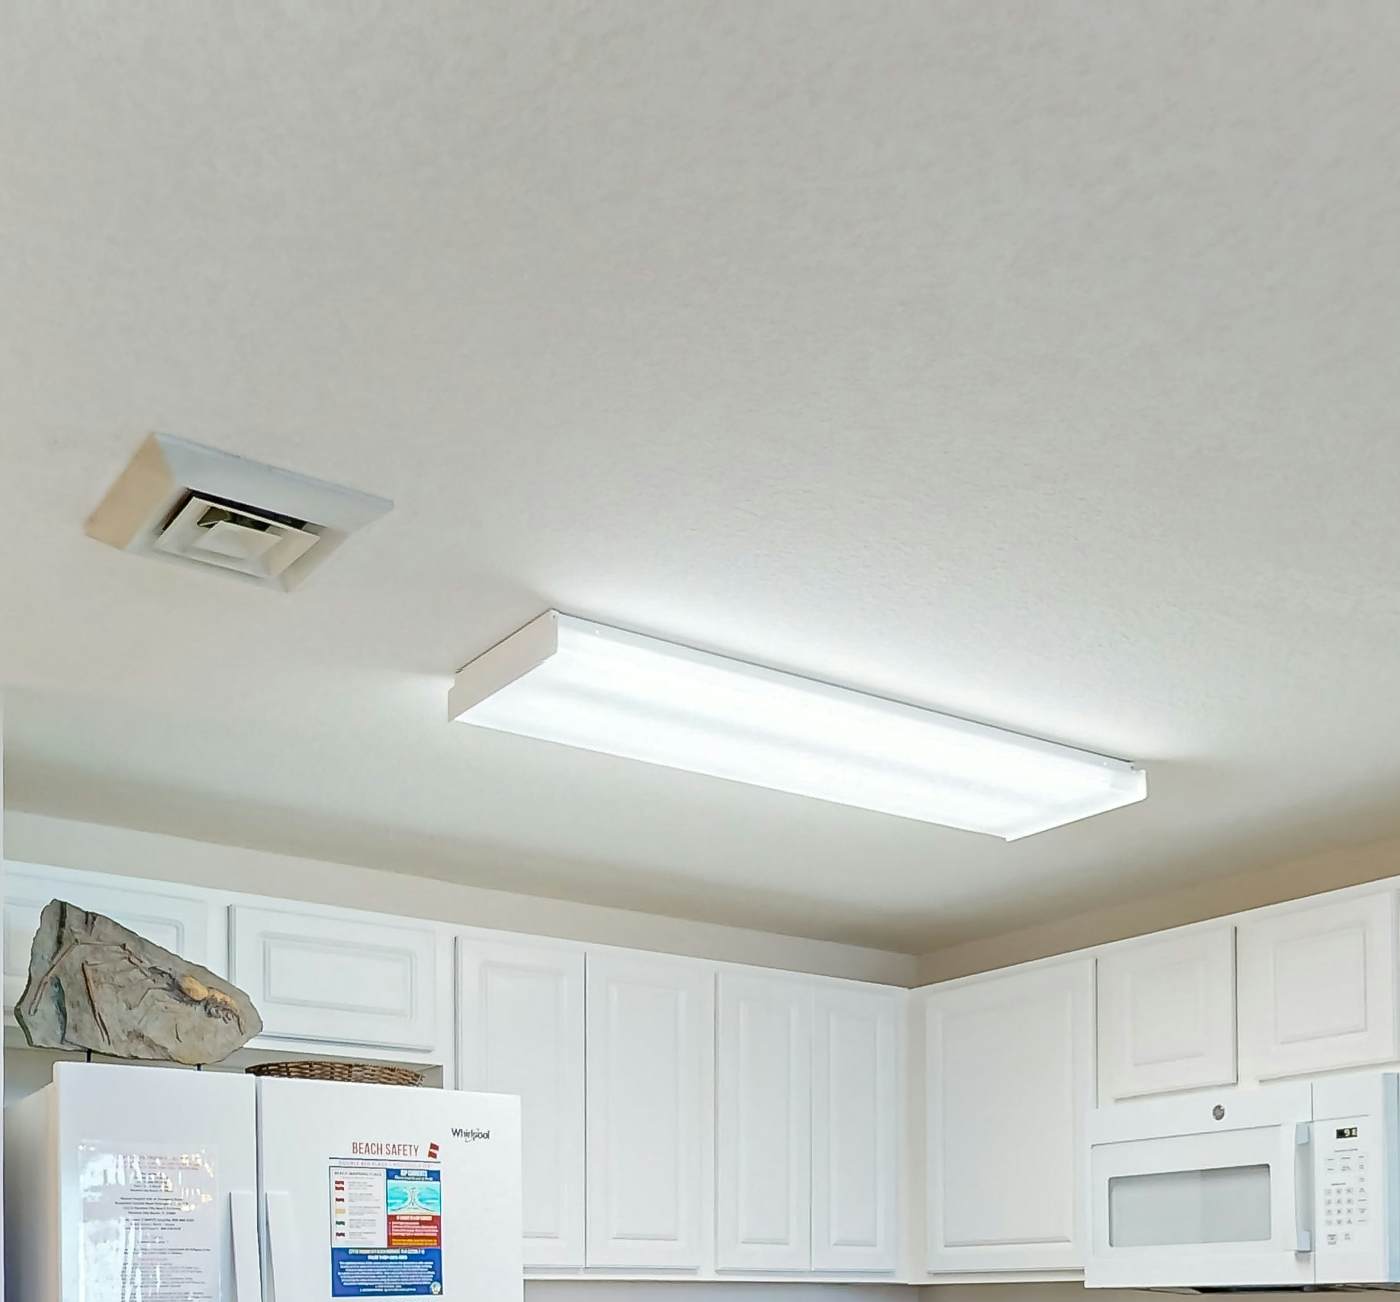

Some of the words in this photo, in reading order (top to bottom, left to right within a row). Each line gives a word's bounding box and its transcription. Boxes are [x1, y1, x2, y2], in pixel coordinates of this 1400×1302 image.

[450, 1127, 490, 1142] Whirlpool
[351, 1142, 383, 1155] BEACH
[385, 1143, 419, 1157] SAFETY
